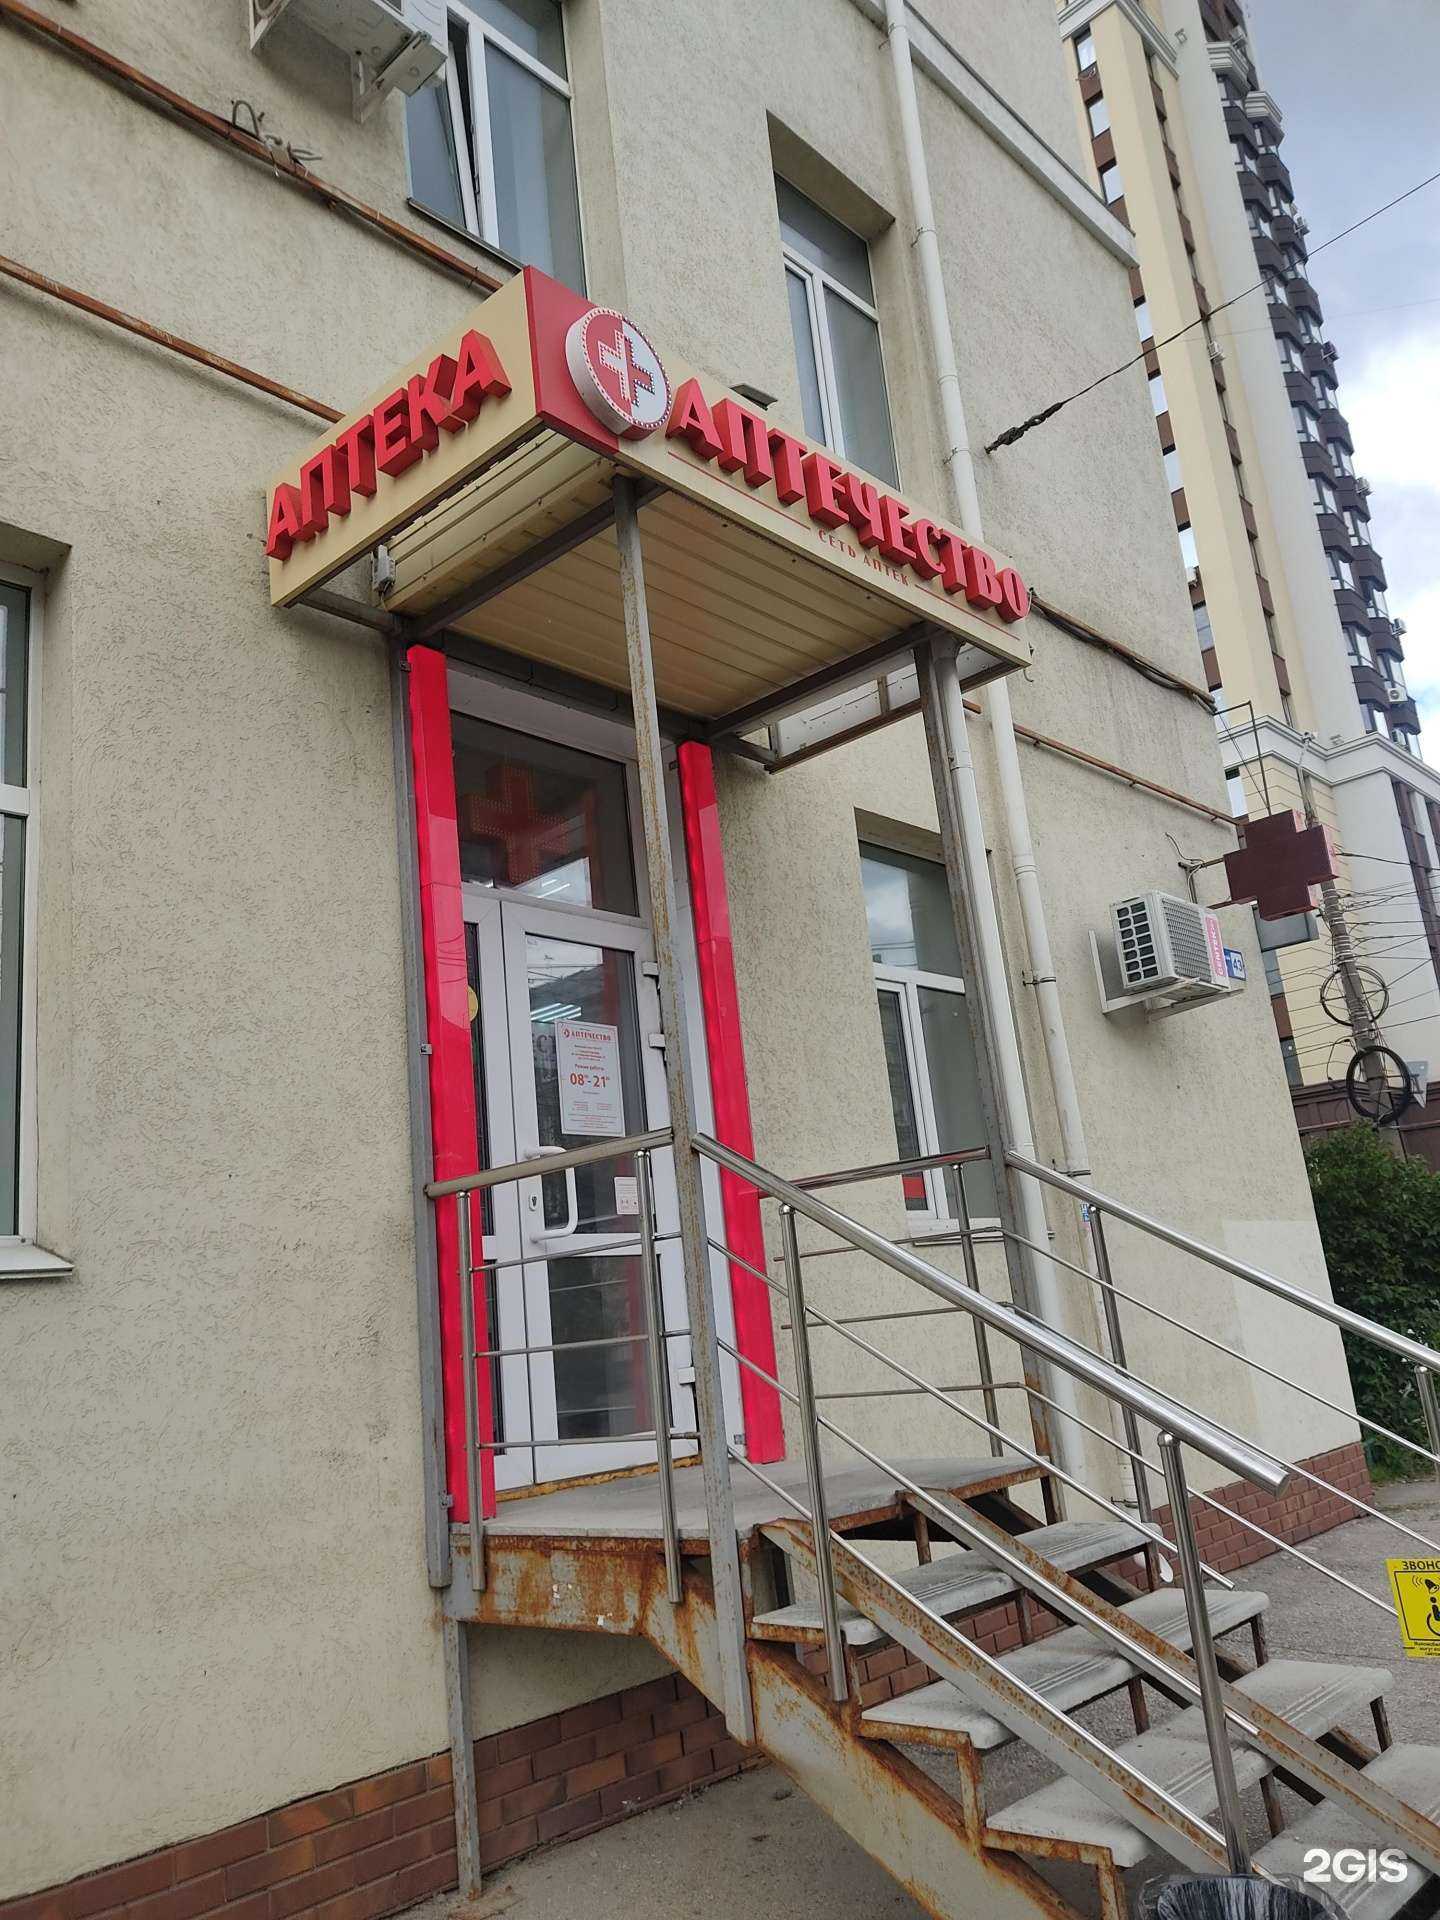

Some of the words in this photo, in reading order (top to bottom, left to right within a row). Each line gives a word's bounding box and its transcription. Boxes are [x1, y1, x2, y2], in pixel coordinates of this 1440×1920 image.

[266, 328, 512, 561] АПТЕКА
[665, 377, 1030, 624] АПТЕЧЕСТВО
[818, 528, 857, 559] СЕТЬ
[863, 554, 909, 587] АПТЕК
